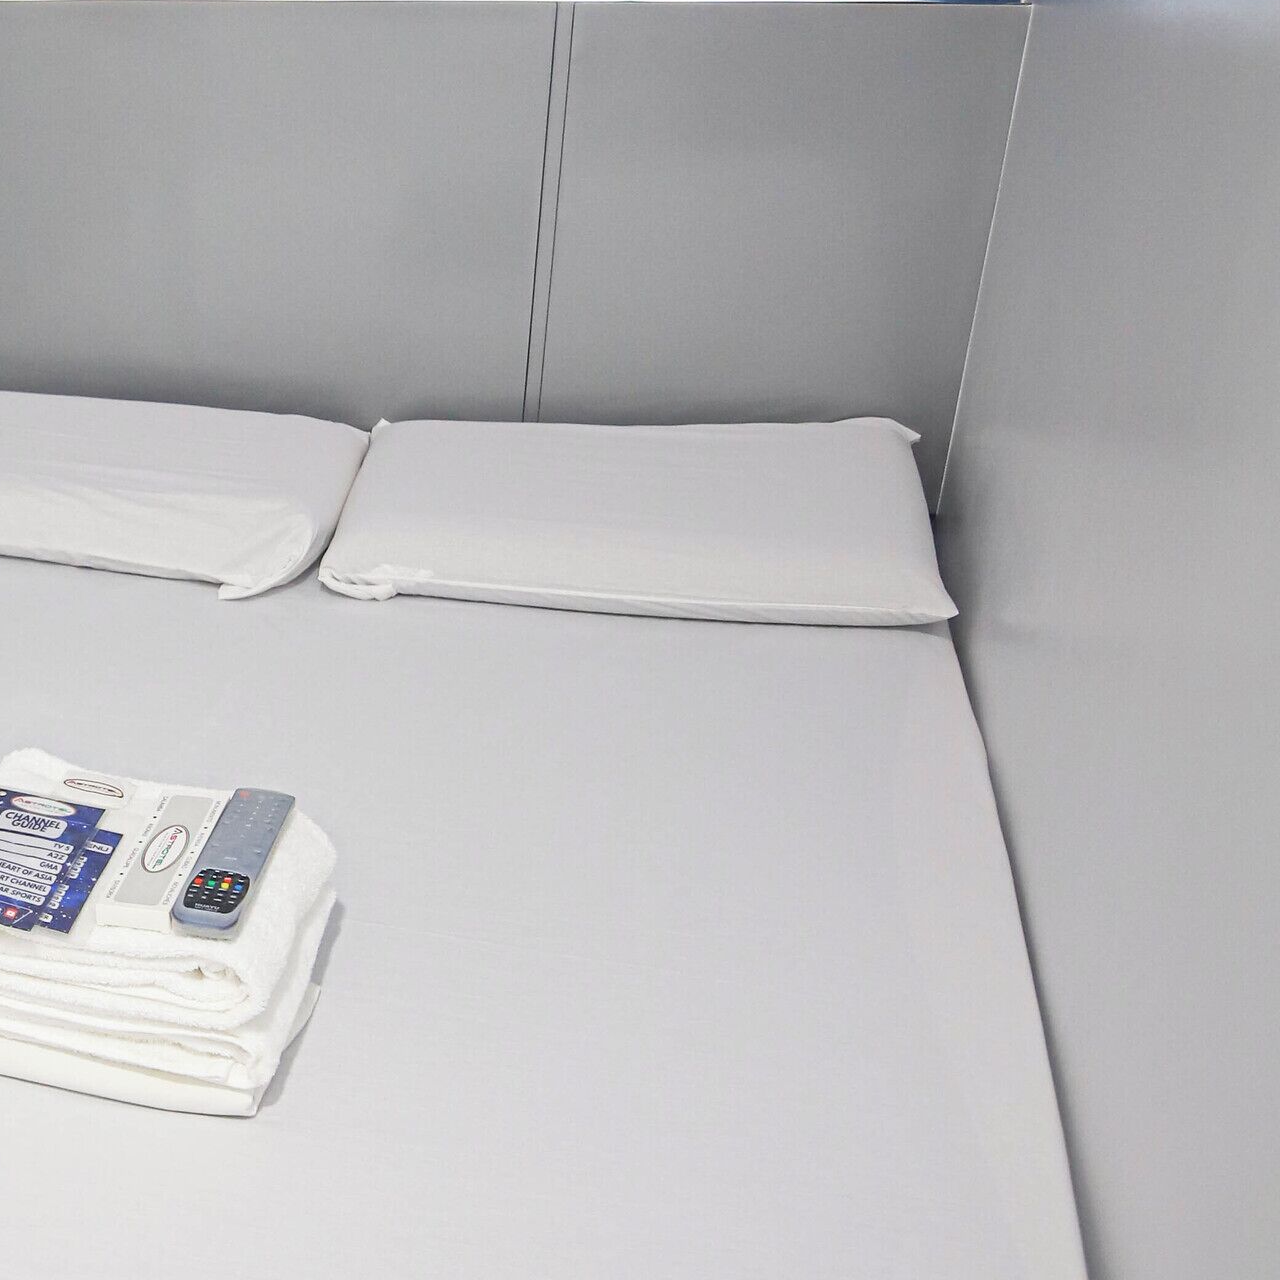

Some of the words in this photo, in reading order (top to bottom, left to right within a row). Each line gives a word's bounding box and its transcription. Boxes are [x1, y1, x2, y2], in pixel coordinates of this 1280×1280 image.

[5, 811, 61, 829] CHANNEL
[11, 819, 47, 833] GUIDE
[151, 827, 183, 869] ASTROTEL
[47, 852, 65, 861] A2Z
[39, 861, 58, 871] GMA
[22, 868, 33, 876] OF
[34, 871, 53, 882] ASIA
[10, 877, 47, 893] CHANNEL
[11, 889, 41, 903] SPORTS
